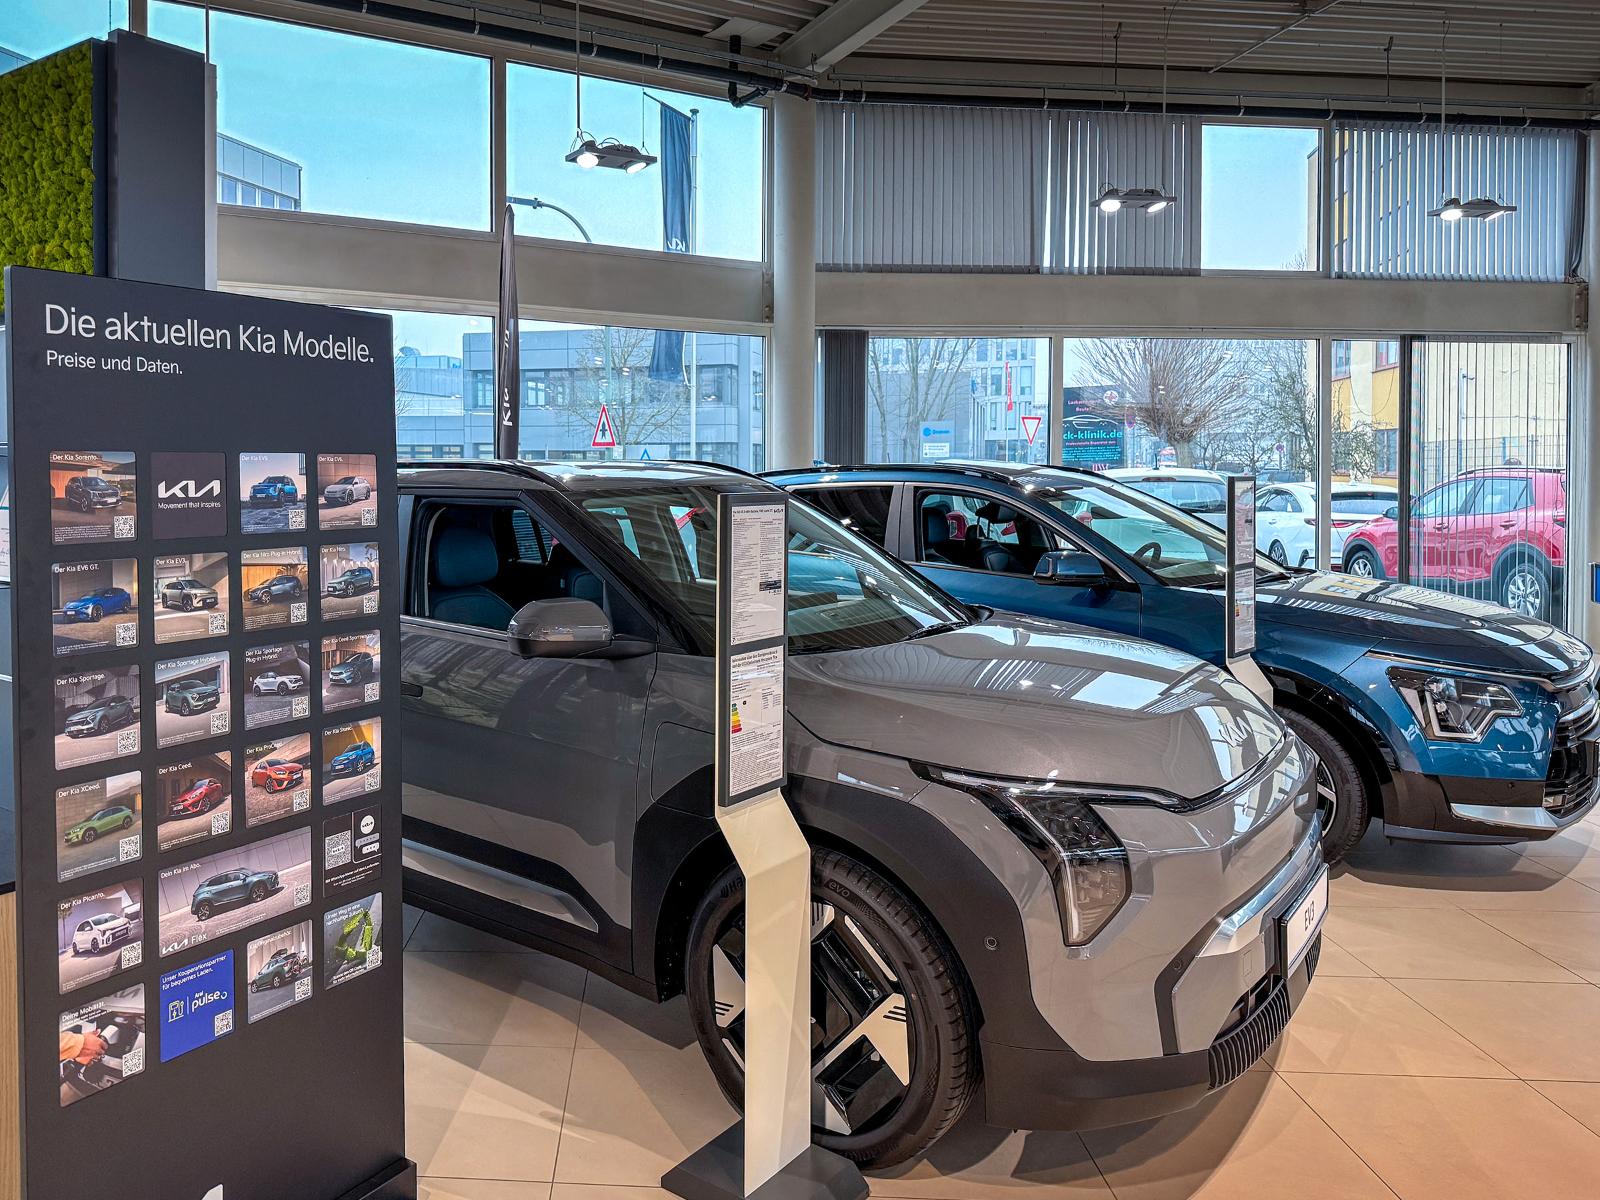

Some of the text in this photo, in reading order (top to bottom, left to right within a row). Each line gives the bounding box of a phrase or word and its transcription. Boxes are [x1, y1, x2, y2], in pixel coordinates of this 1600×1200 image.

[45, 303, 375, 363] Die aktuellen Kia Modelle.
[46, 350, 183, 375] Preise und Daten.
[158, 479, 221, 499] KIA
[157, 501, 221, 510] Movement that inspires
[67, 565, 76, 573] Kia
[177, 658, 199, 667] Sportage
[56, 673, 105, 686] Der Kia Sportage.
[158, 767, 168, 775] Der
[178, 763, 193, 771] Ceed.
[58, 783, 101, 798] Der Kia XCeed.
[160, 869, 173, 879] Dein
[173, 867, 182, 876] Kia
[828, 880, 850, 897] evo
[60, 901, 71, 910] Der
[72, 898, 82, 907] Kia
[1304, 900, 1315, 931] EV3
[162, 933, 208, 955] KIA Flex
[162, 954, 227, 984] Unser Kooperationspartner
[162, 982, 171, 991] für
[171, 973, 197, 988] bequemes
[191, 990, 221, 1013] pulse
[61, 1011, 79, 1022] Deine
